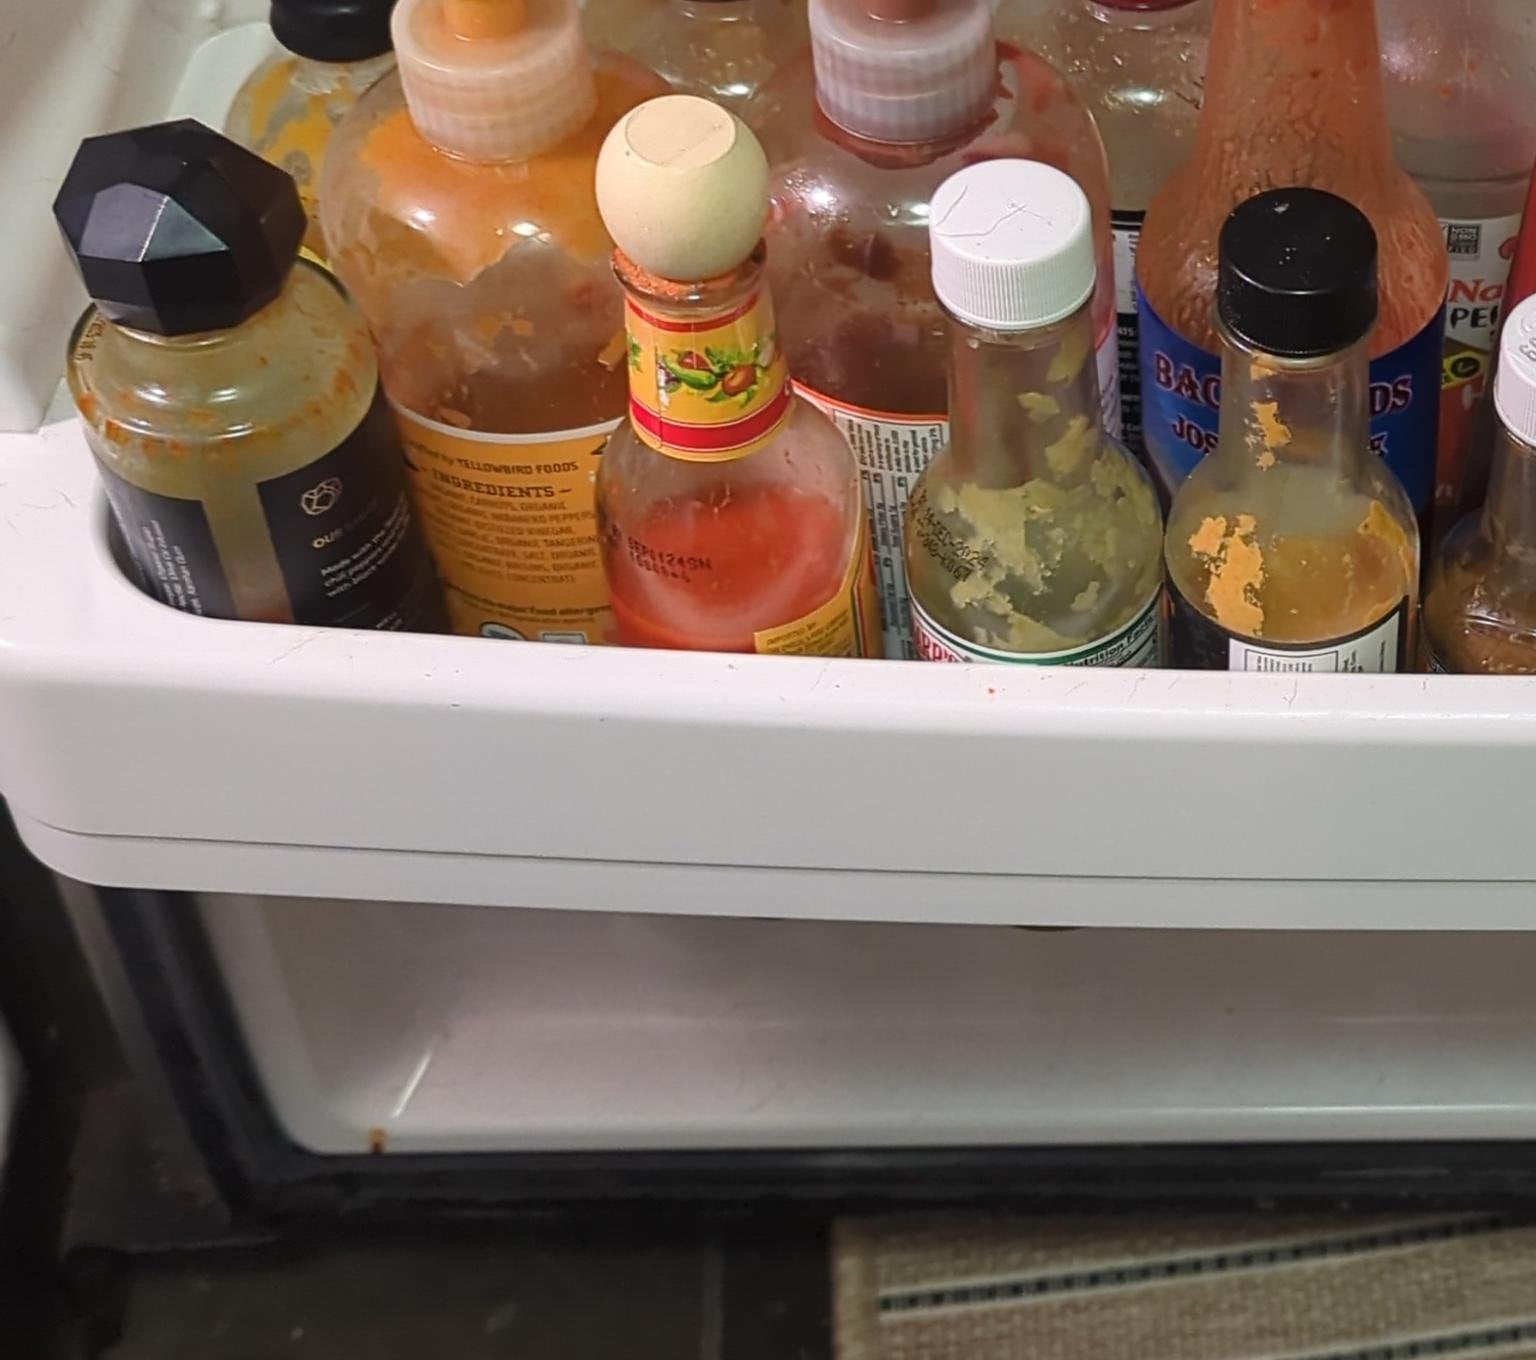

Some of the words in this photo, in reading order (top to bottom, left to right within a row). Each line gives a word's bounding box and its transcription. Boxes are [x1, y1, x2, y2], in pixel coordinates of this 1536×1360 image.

[456, 457, 533, 476] YELLOWBIRD
[536, 460, 579, 475] FOODS
[432, 468, 556, 498] INGREDIENTS
[1063, 641, 1127, 668] utrition
